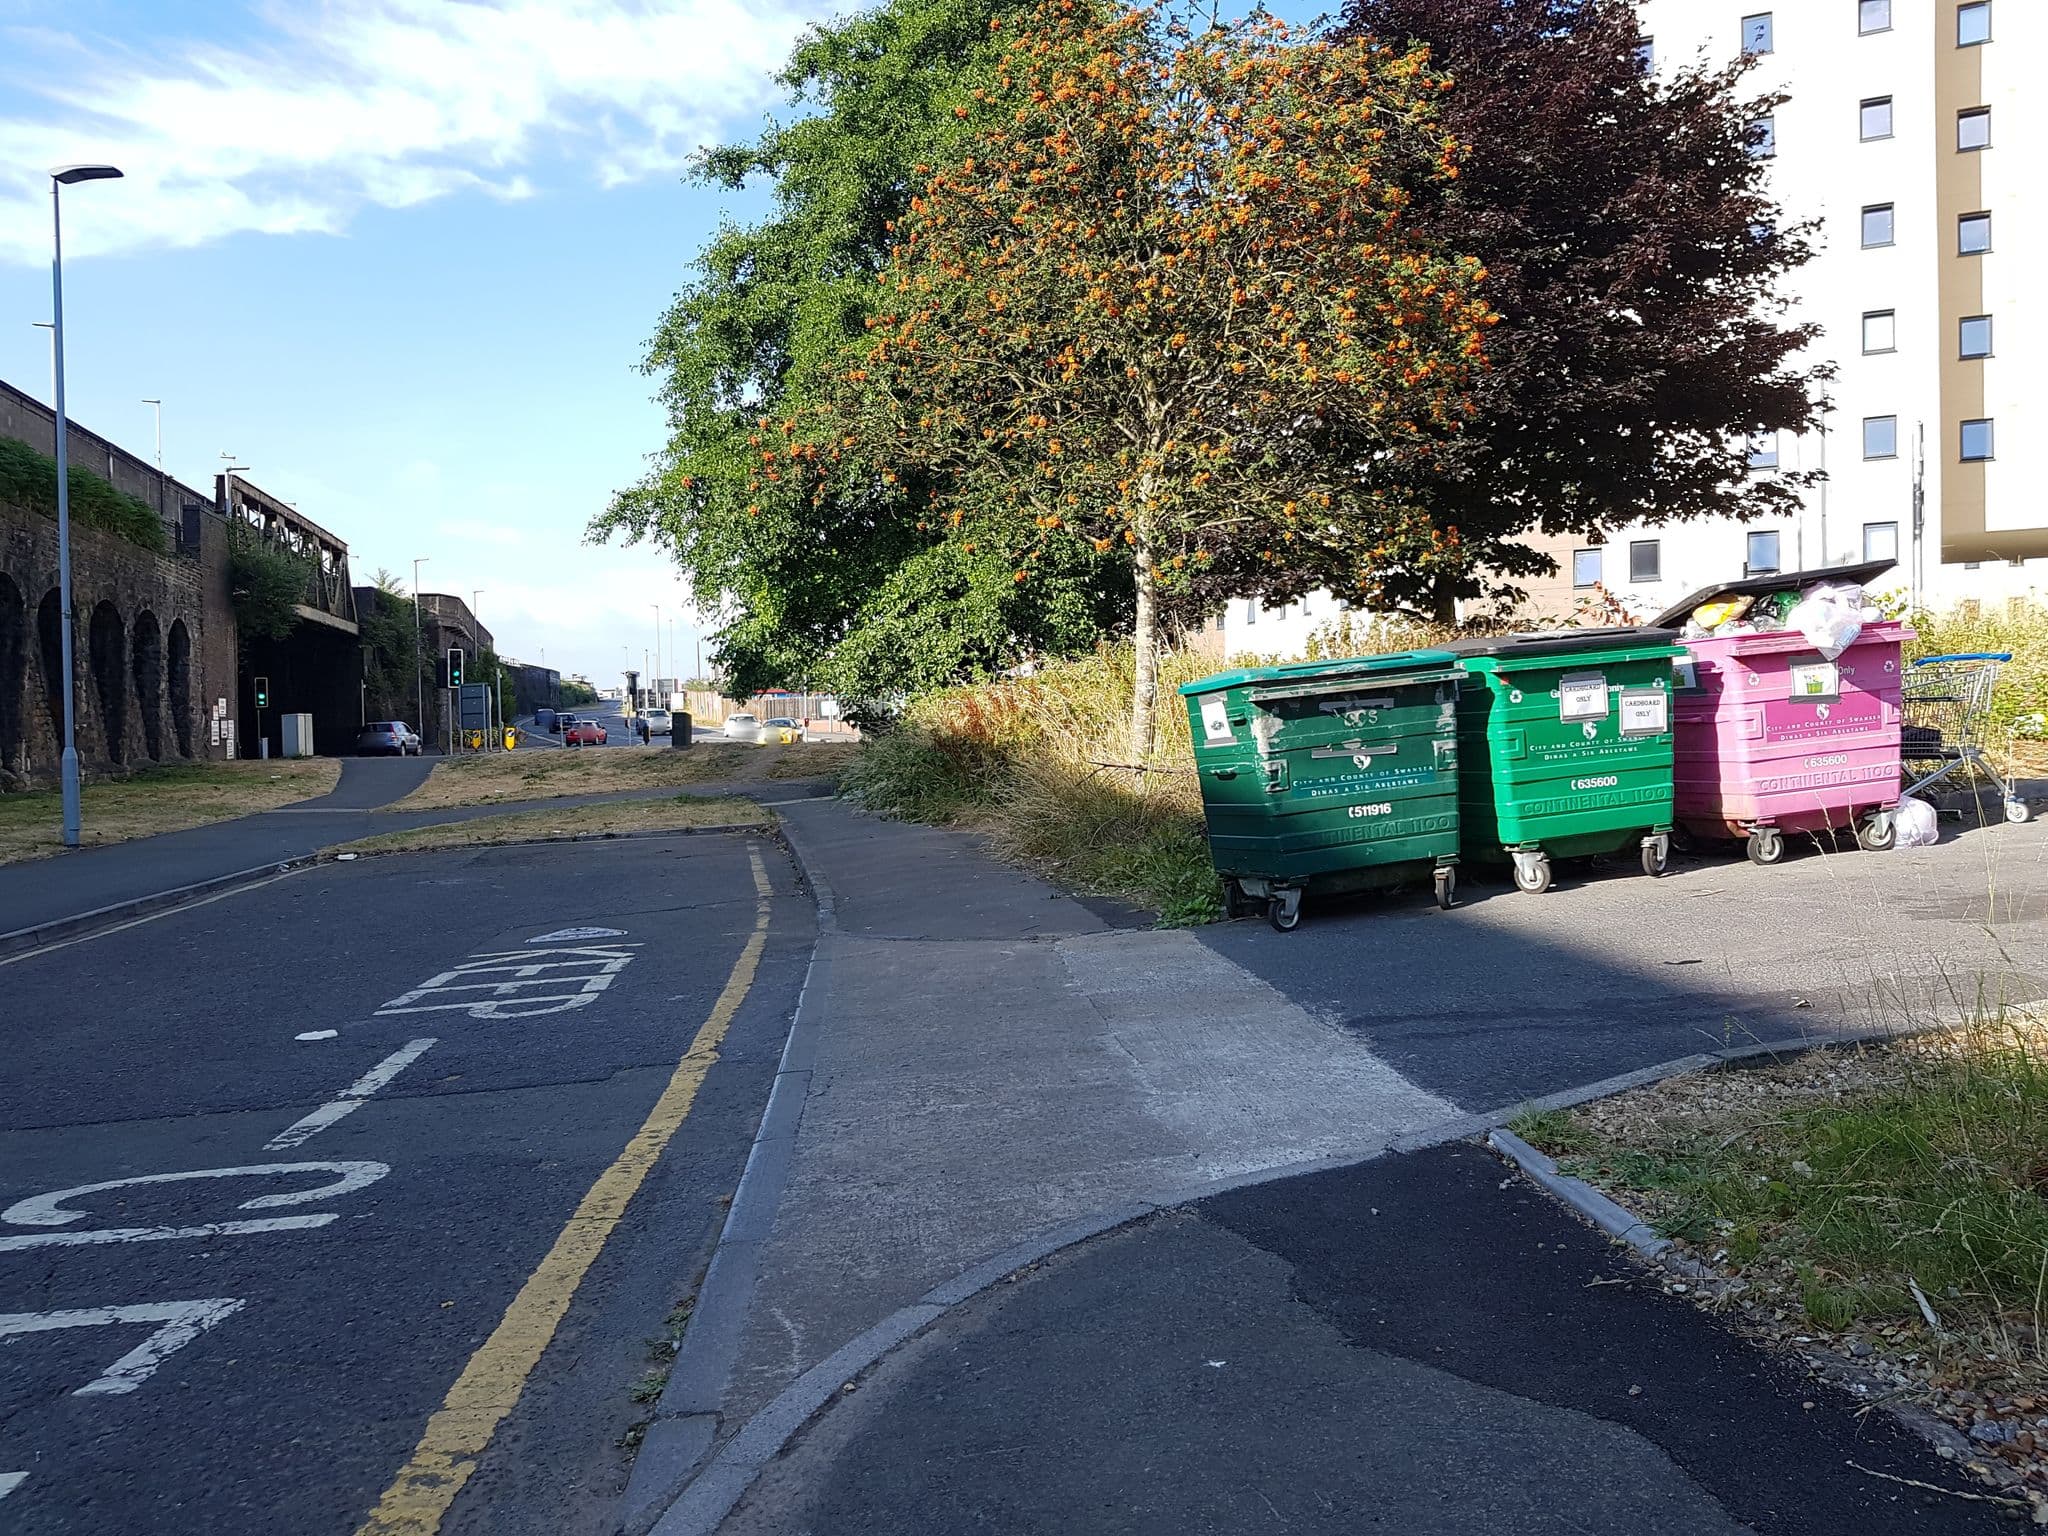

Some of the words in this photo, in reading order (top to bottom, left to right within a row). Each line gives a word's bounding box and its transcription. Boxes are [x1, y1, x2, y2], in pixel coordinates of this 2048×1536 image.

[1625, 699, 1661, 707] CARDBOARD
[1811, 755, 1848, 768] 635600
[1577, 776, 1618, 789] 635600
[1760, 770, 1857, 791] CONTINENTAL
[1354, 803, 1392, 817] 511916
[1524, 792, 1628, 815] CONTINENTAL
[1317, 821, 1406, 845] TINENTAL
[372, 942, 646, 1019] KEEP
